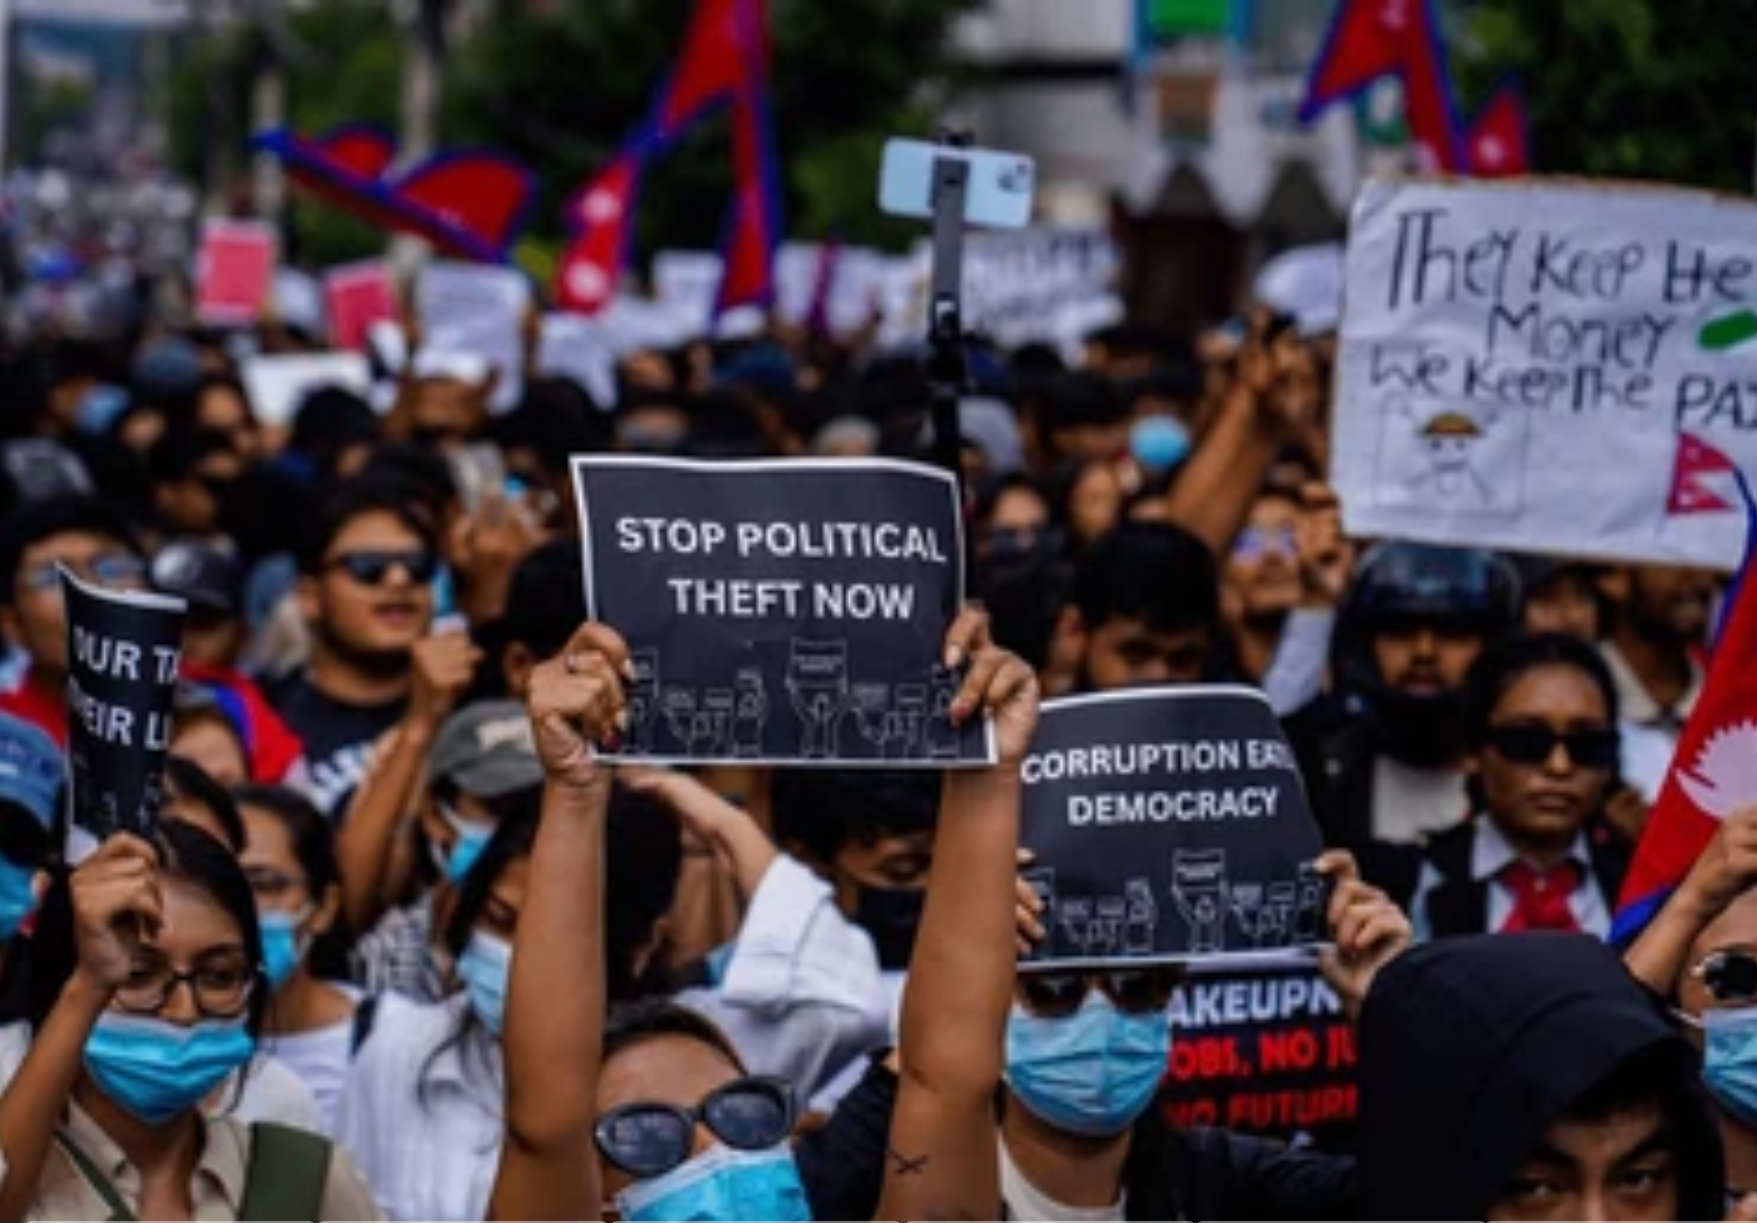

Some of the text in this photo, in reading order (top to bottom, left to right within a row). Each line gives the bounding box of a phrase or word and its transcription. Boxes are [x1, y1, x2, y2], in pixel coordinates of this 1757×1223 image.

[615, 517, 947, 563] STOP POLITICAL
[668, 578, 915, 619] THEFT NOW
[1020, 740, 1240, 783] CORRUPTION
[1067, 787, 1279, 826] DEMOCRACY
[1164, 1036, 1253, 1083] OBS,
[1259, 1024, 1319, 1075] NO
